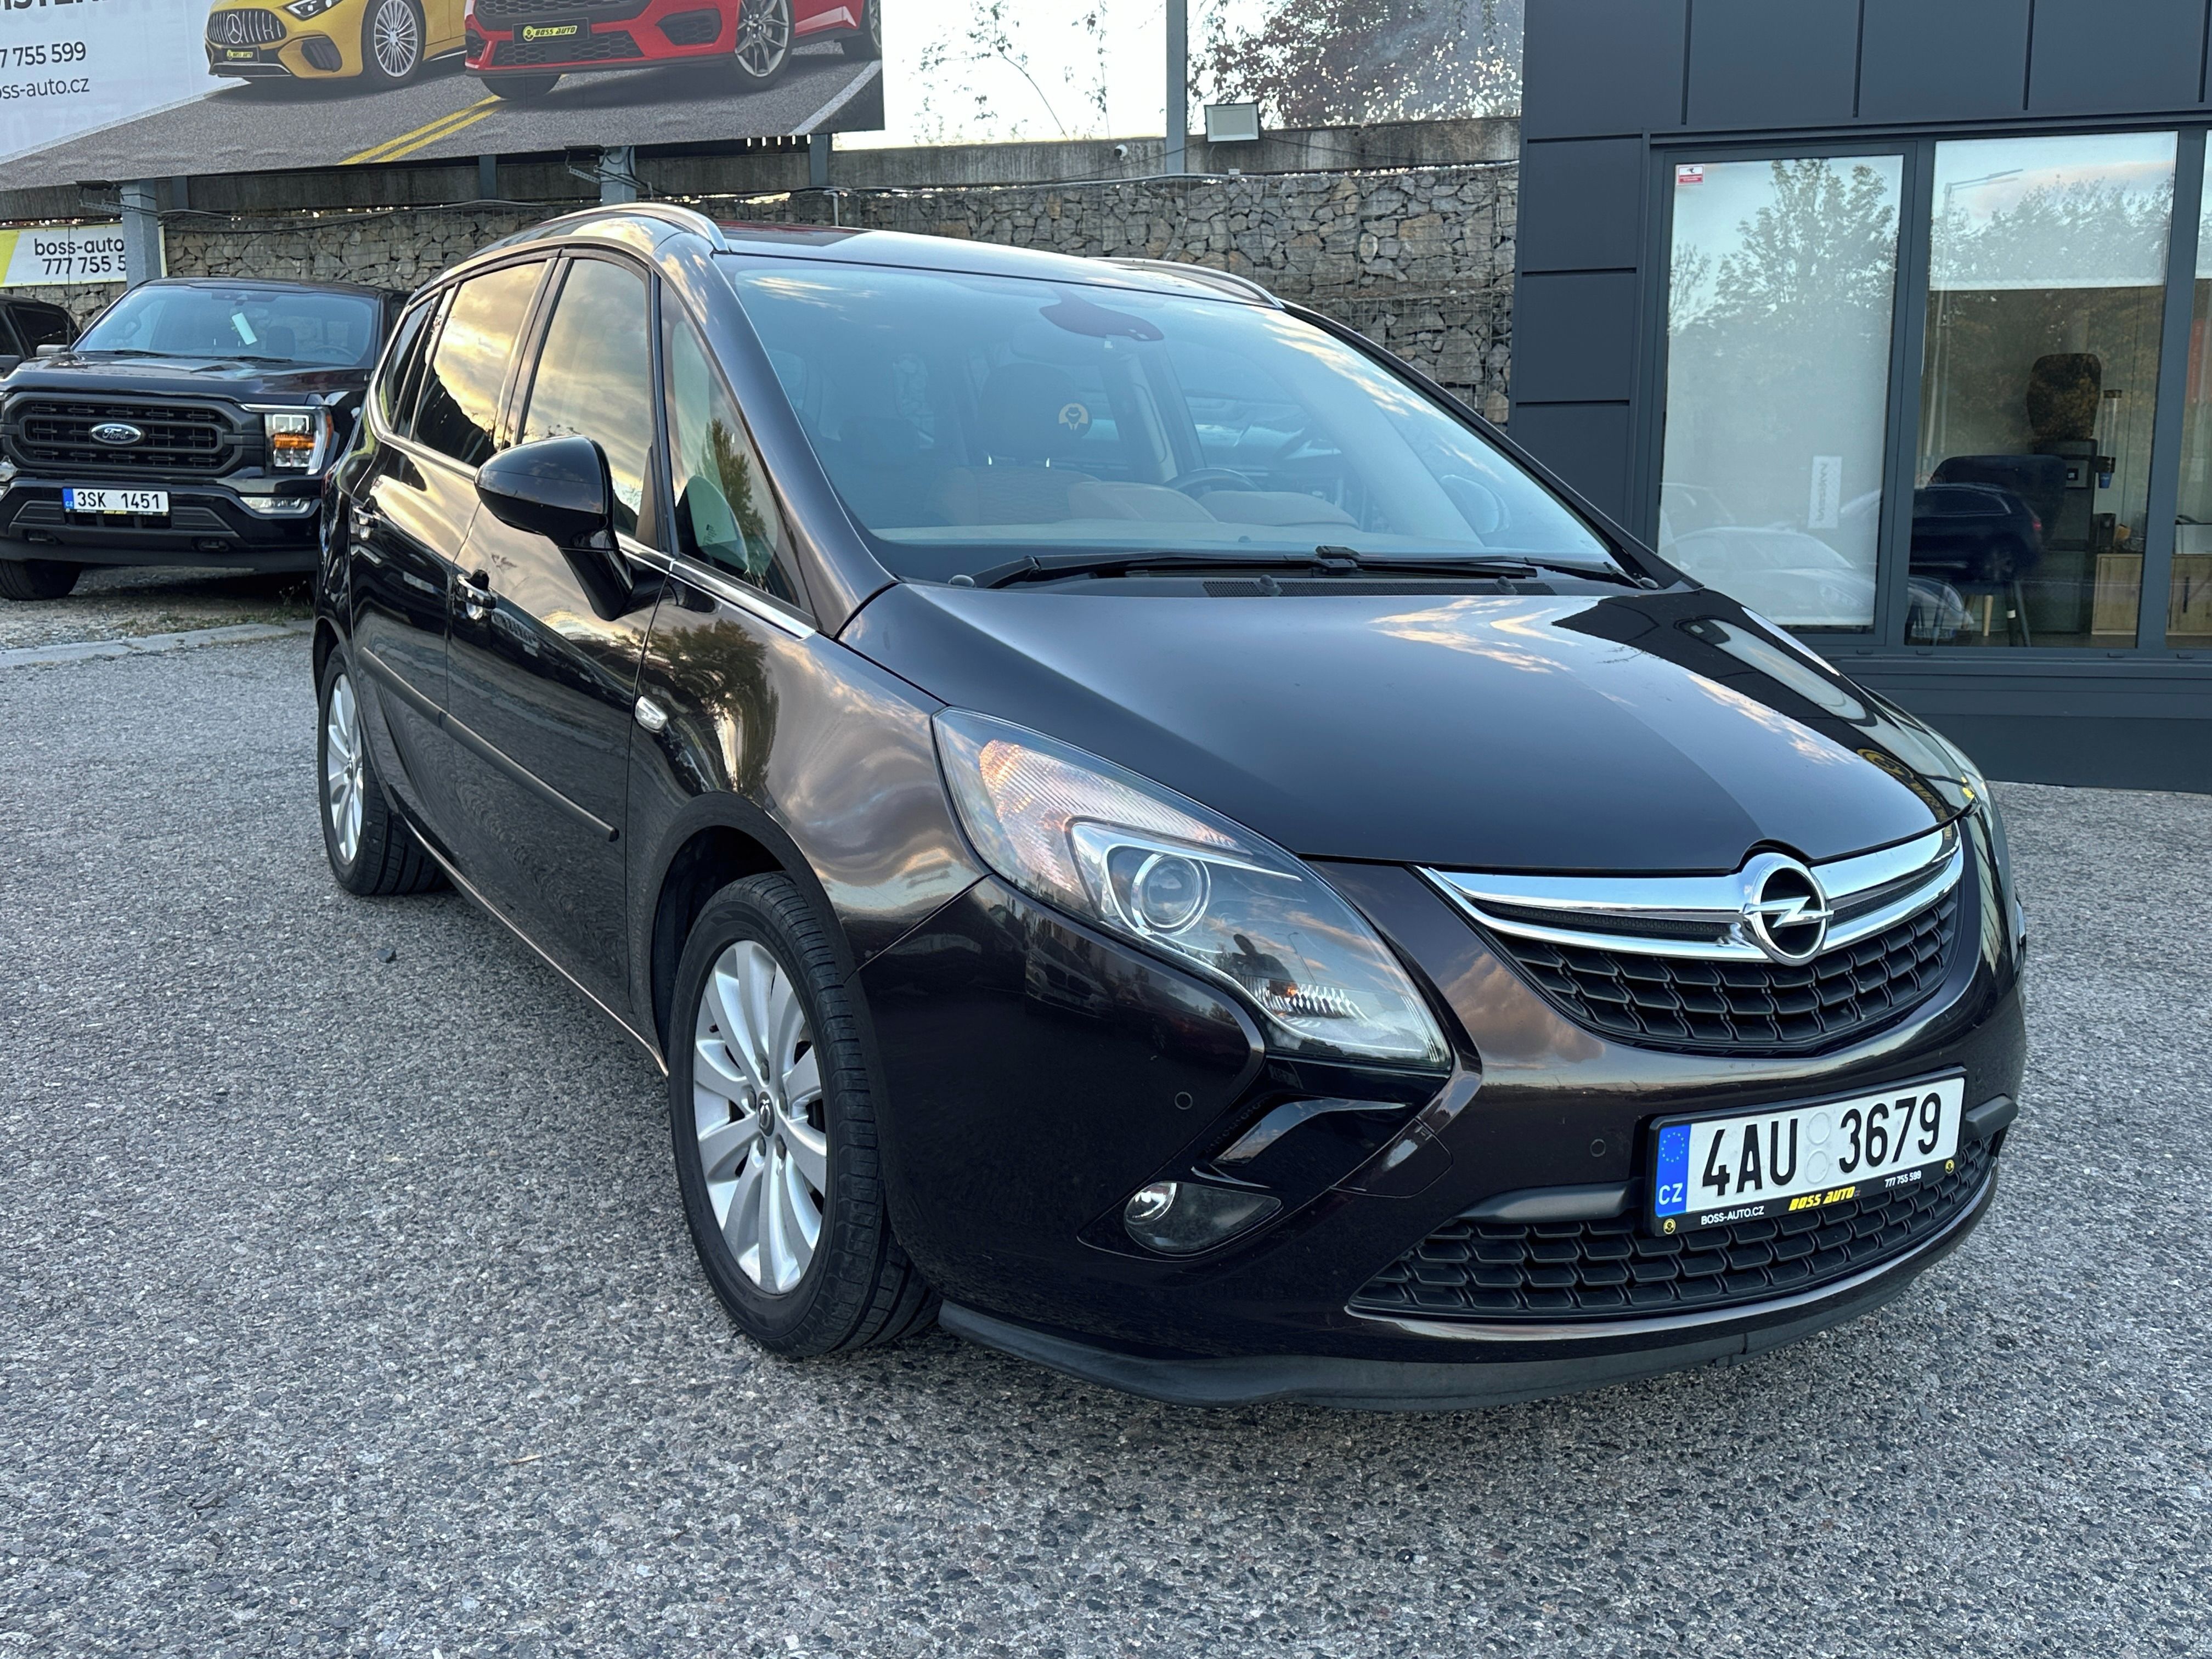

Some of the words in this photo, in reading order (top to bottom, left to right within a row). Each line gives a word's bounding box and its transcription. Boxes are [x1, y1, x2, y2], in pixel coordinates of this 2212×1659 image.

[13, 45, 46, 66] 755
[52, 41, 86, 63] 599
[0, 78, 90, 99] ss-auto.cz
[35, 238, 125, 256] boss-auto
[42, 258, 72, 275] 777
[78, 256, 111, 274] 755
[77, 492, 106, 508] 3SK
[121, 493, 159, 509] 1451
[1702, 1118, 1798, 1197] 4AU
[1839, 1092, 1942, 1173] 3679
[1884, 1177, 1896, 1188] 777
[1897, 1173, 1909, 1185] 755
[1909, 1170, 1922, 1182] 599
[1658, 1182, 1683, 1205] CZ
[1788, 1194, 1822, 1211] BOSS
[1822, 1186, 1856, 1204] AUTO
[1701, 1205, 1764, 1225] BOSS-AUTO.CZ
